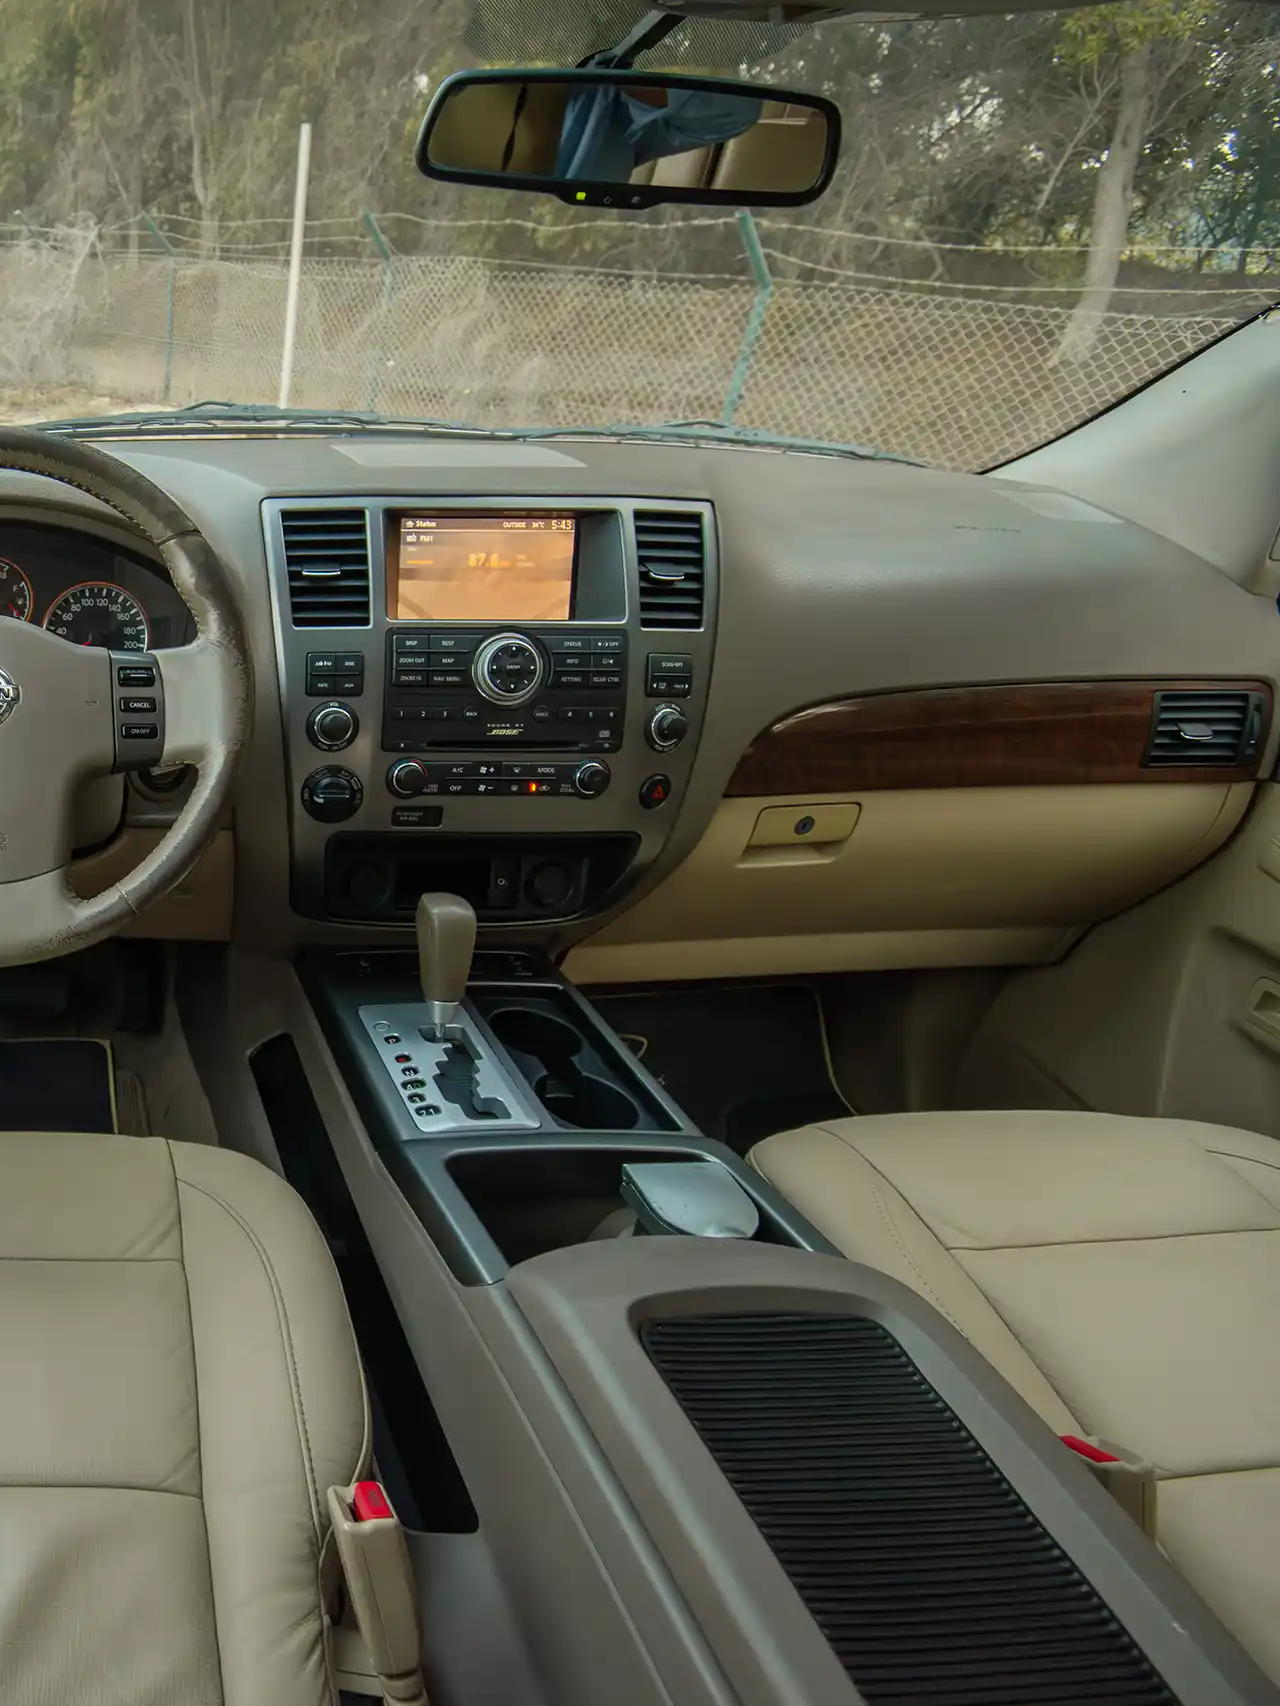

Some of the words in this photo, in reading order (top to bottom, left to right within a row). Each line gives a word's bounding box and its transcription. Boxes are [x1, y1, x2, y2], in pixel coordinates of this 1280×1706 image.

[415, 520, 437, 528] Status
[502, 521, 527, 529] OUTSIDE
[551, 519, 573, 530] 5:43
[81, 598, 95, 607] 100
[96, 598, 109, 607] 120
[70, 603, 82, 612] 80
[108, 603, 121, 612] 140
[62, 612, 74, 621] 60
[116, 612, 130, 621] 160
[56, 626, 67, 635] 40
[123, 626, 137, 635] 180
[124, 640, 138, 649] 200
[129, 701, 151, 709] CANCEL
[421, 710, 426, 718] 2
[443, 710, 448, 718] 3
[406, 1069, 415, 1077] N
